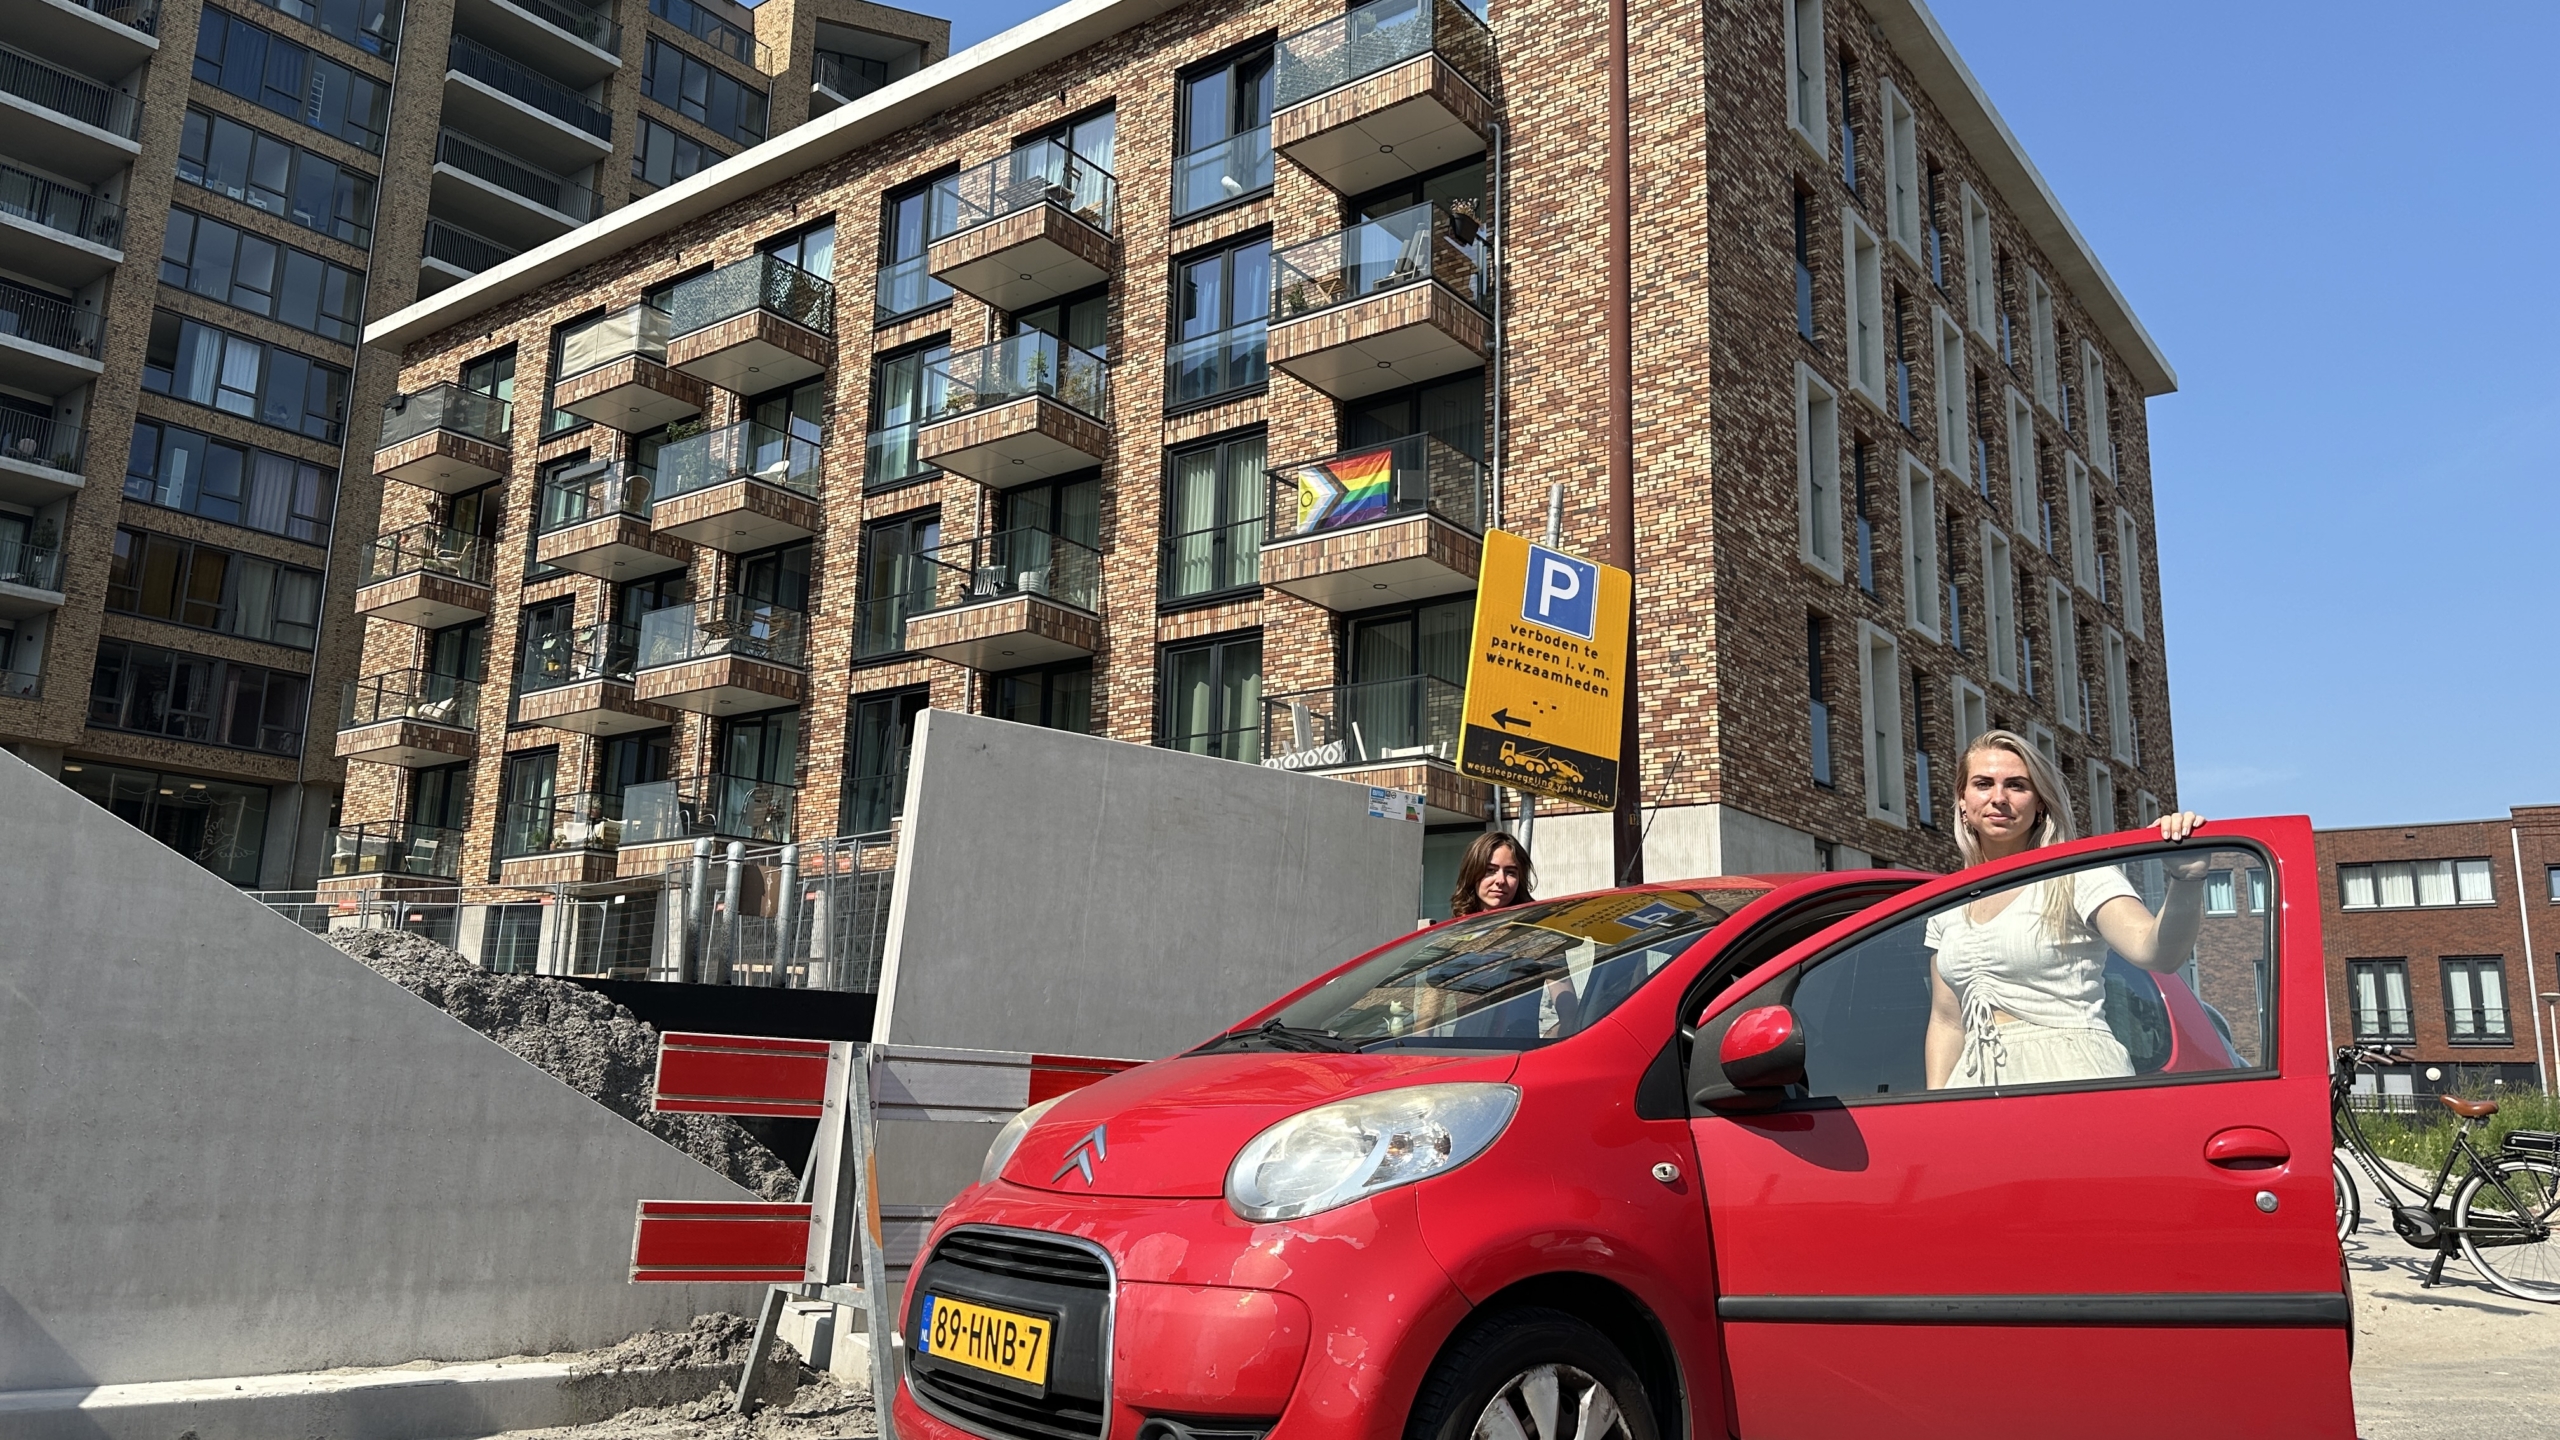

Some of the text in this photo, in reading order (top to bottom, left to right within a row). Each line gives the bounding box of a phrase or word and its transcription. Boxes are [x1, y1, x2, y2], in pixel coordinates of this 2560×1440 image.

[1539, 558, 1580, 617] P
[1491, 636, 1611, 681] parkeren i.v.m.
[1510, 624, 1599, 660] verboden te
[1486, 651, 1609, 697] werkzaamheden
[1467, 761, 1610, 803] wegsleepregeling van kracht
[920, 1306, 1043, 1372] NL 89-HNB-7
